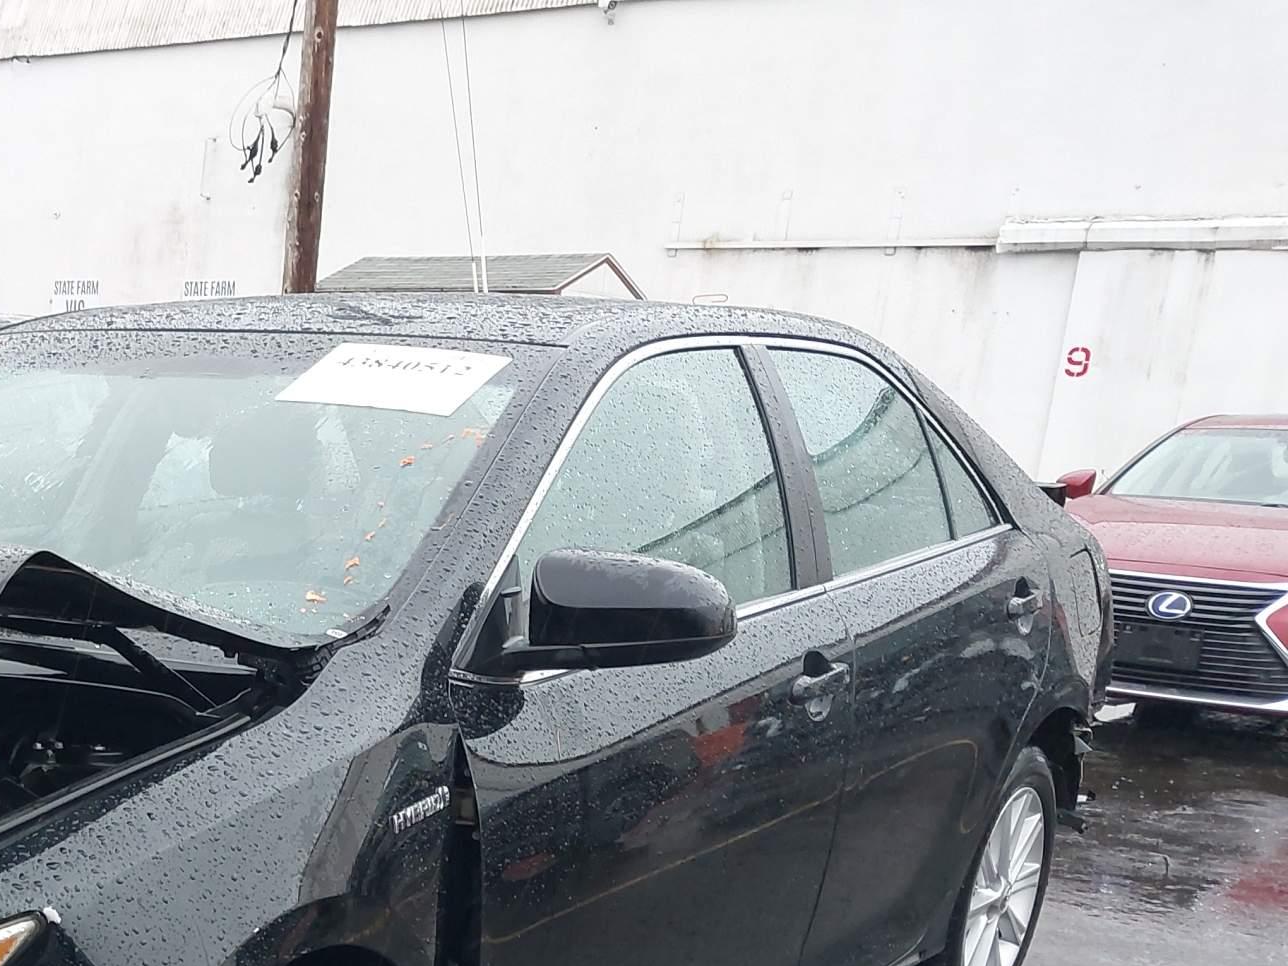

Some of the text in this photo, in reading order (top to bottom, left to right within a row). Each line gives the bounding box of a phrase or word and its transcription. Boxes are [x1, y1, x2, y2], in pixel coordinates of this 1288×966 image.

[53, 280, 99, 296] STATE FARM
[184, 281, 236, 297] STATE FARM
[1064, 347, 1091, 377] 9
